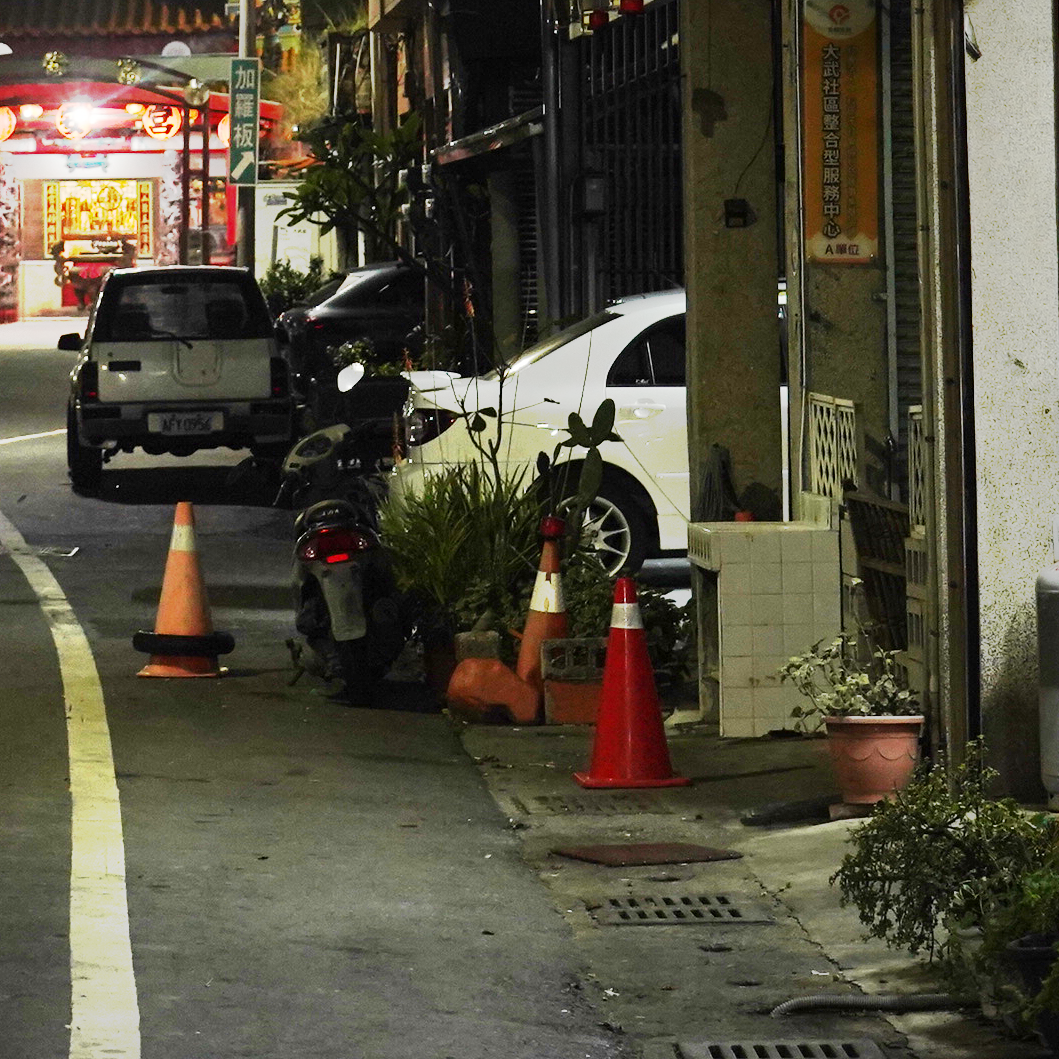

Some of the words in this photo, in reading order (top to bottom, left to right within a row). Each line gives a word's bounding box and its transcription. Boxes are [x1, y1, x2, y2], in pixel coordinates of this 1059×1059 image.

[822, 43, 842, 240] 大武社區整合型服務中心
